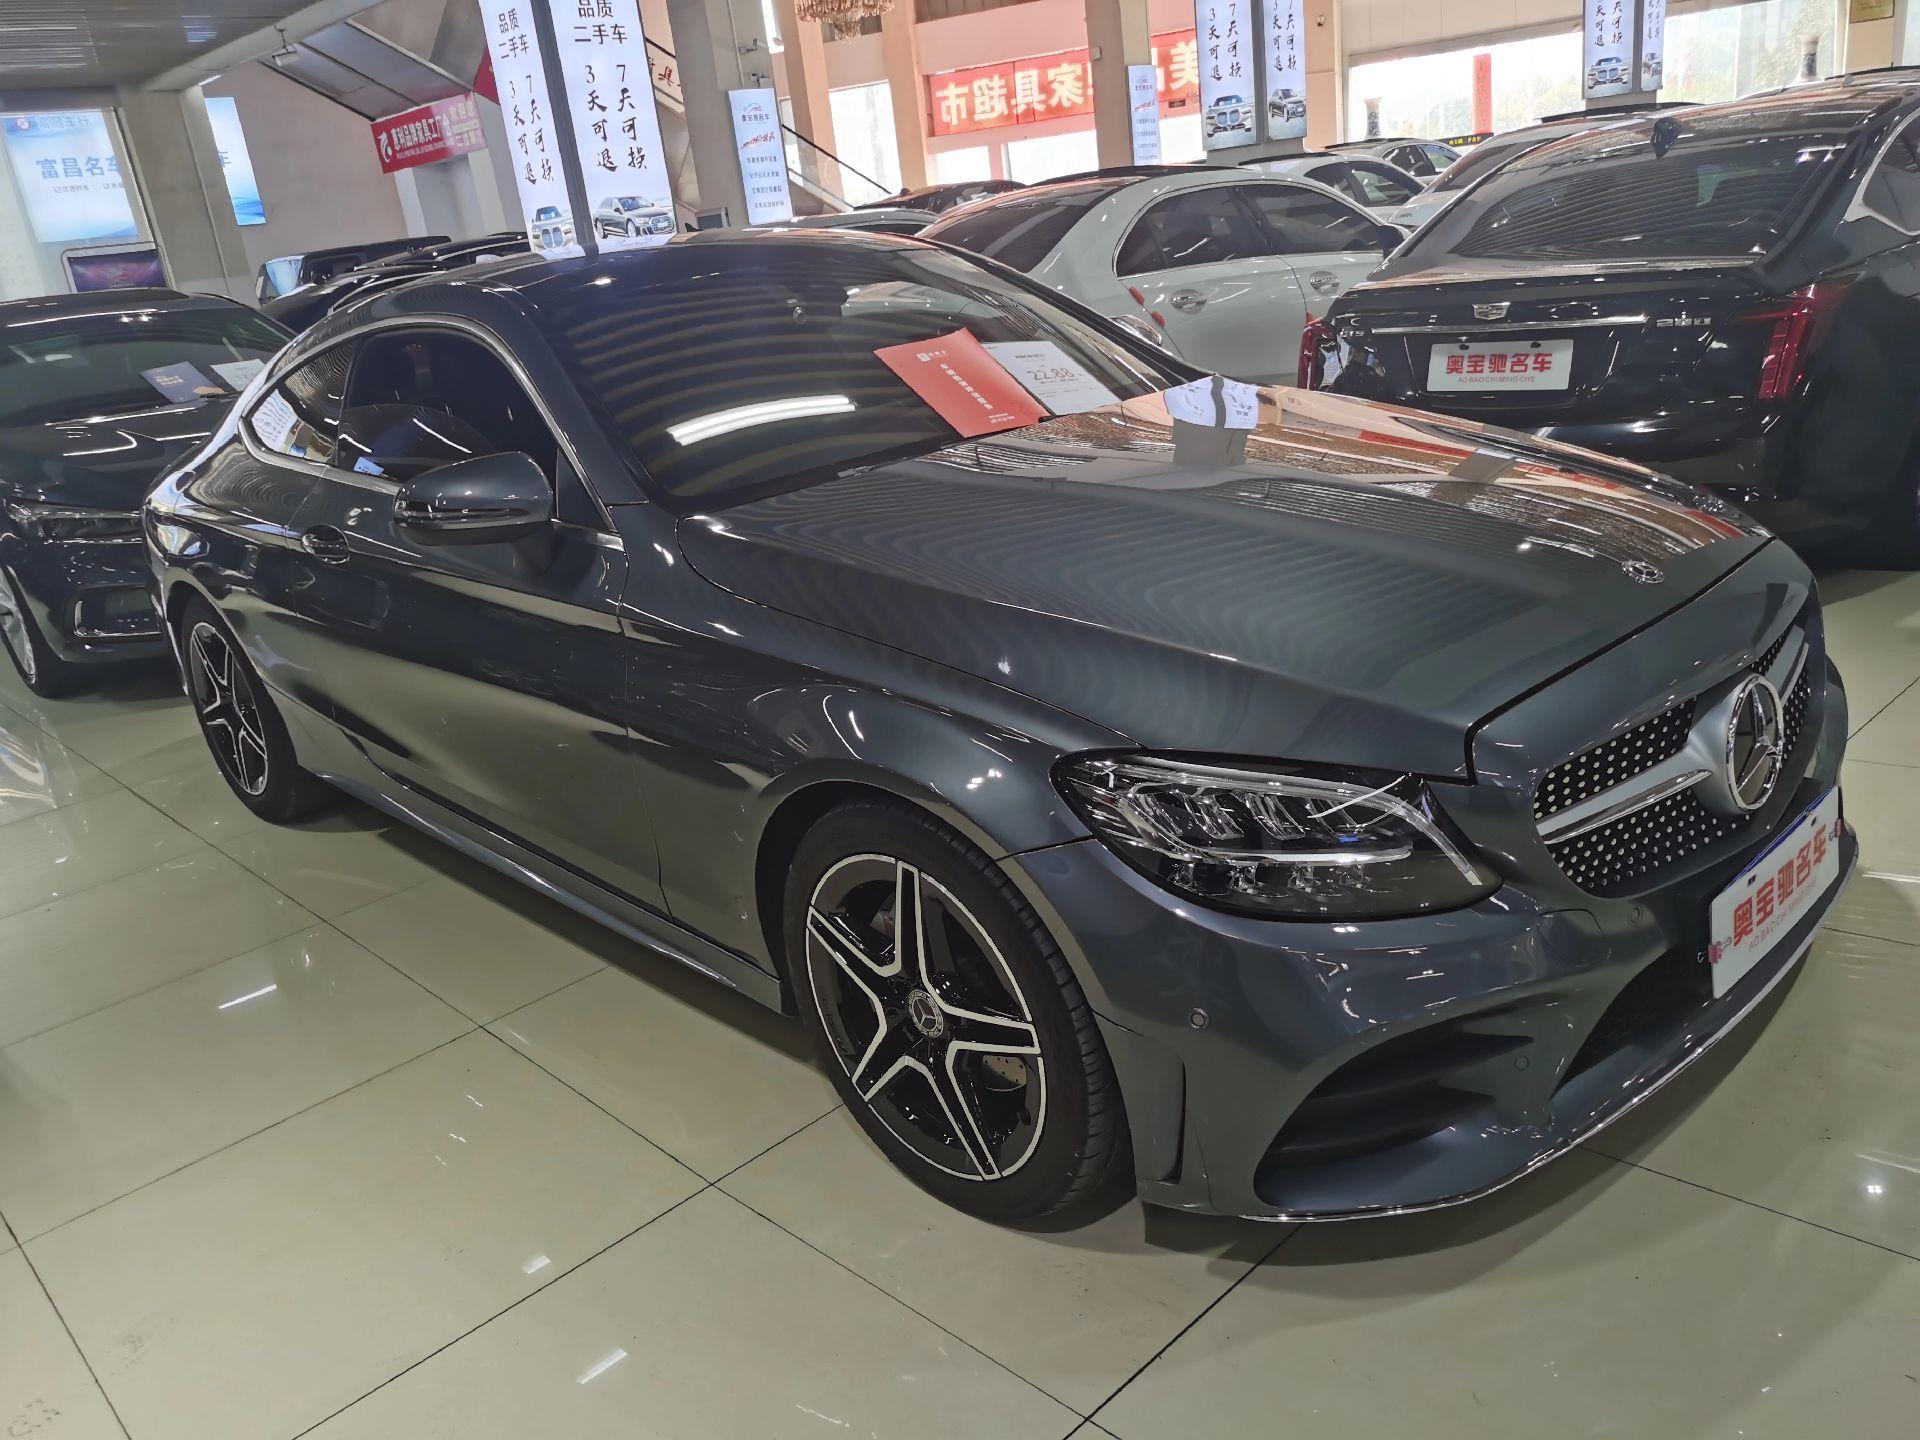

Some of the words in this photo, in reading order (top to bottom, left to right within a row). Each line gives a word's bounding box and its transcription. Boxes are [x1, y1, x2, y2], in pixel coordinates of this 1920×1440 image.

[498, 8, 520, 34] 品质
[578, 0, 614, 18] 品质
[498, 33, 530, 59] 二手车
[573, 23, 628, 45] 二手车
[1445, 352, 1553, 375] 奥宝驰名车
[1733, 823, 1828, 948] 奥宝驰名车
